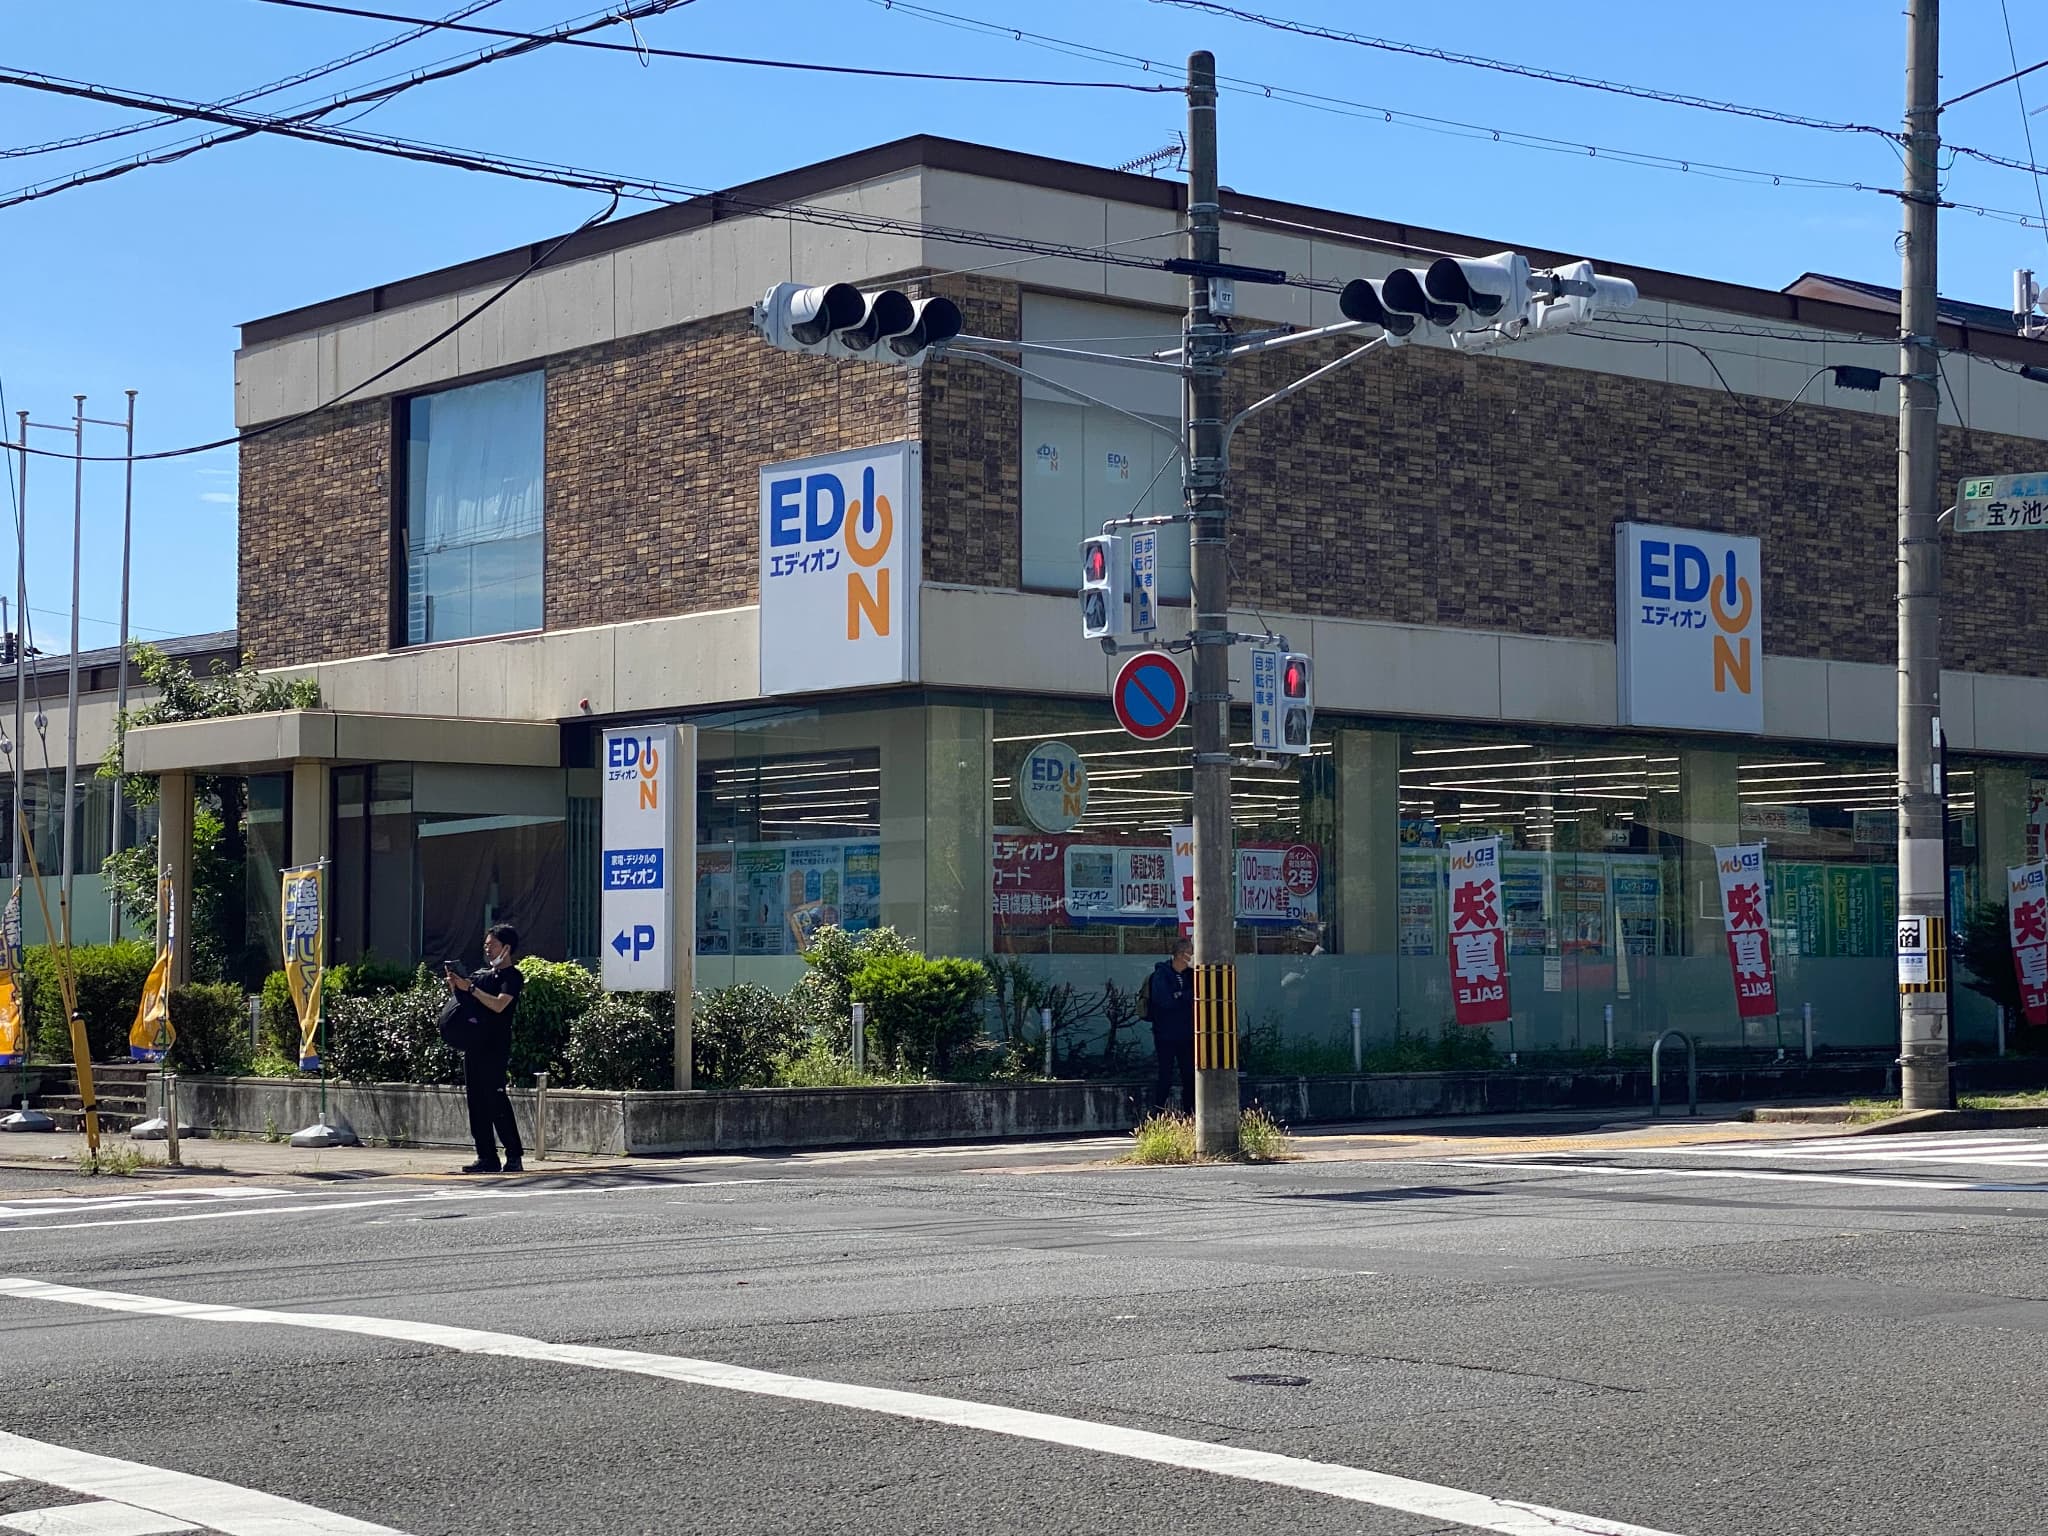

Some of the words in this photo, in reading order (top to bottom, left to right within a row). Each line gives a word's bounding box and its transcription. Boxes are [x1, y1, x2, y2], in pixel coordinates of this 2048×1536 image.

[1107, 453, 1129, 480] EDION
[770, 466, 893, 640] EDION
[770, 548, 840, 577] エディオン
[1640, 540, 1753, 694] EDION
[1641, 605, 1707, 629] エディオン
[608, 736, 659, 810] EDION
[608, 769, 638, 781] エディオン
[1032, 757, 1083, 817] EDION
[993, 841, 1060, 861] エディオン
[611, 868, 657, 885] エディオン
[1288, 869, 1313, 888] 2年
[1072, 890, 1109, 900] エディオン
[633, 924, 655, 962] P
